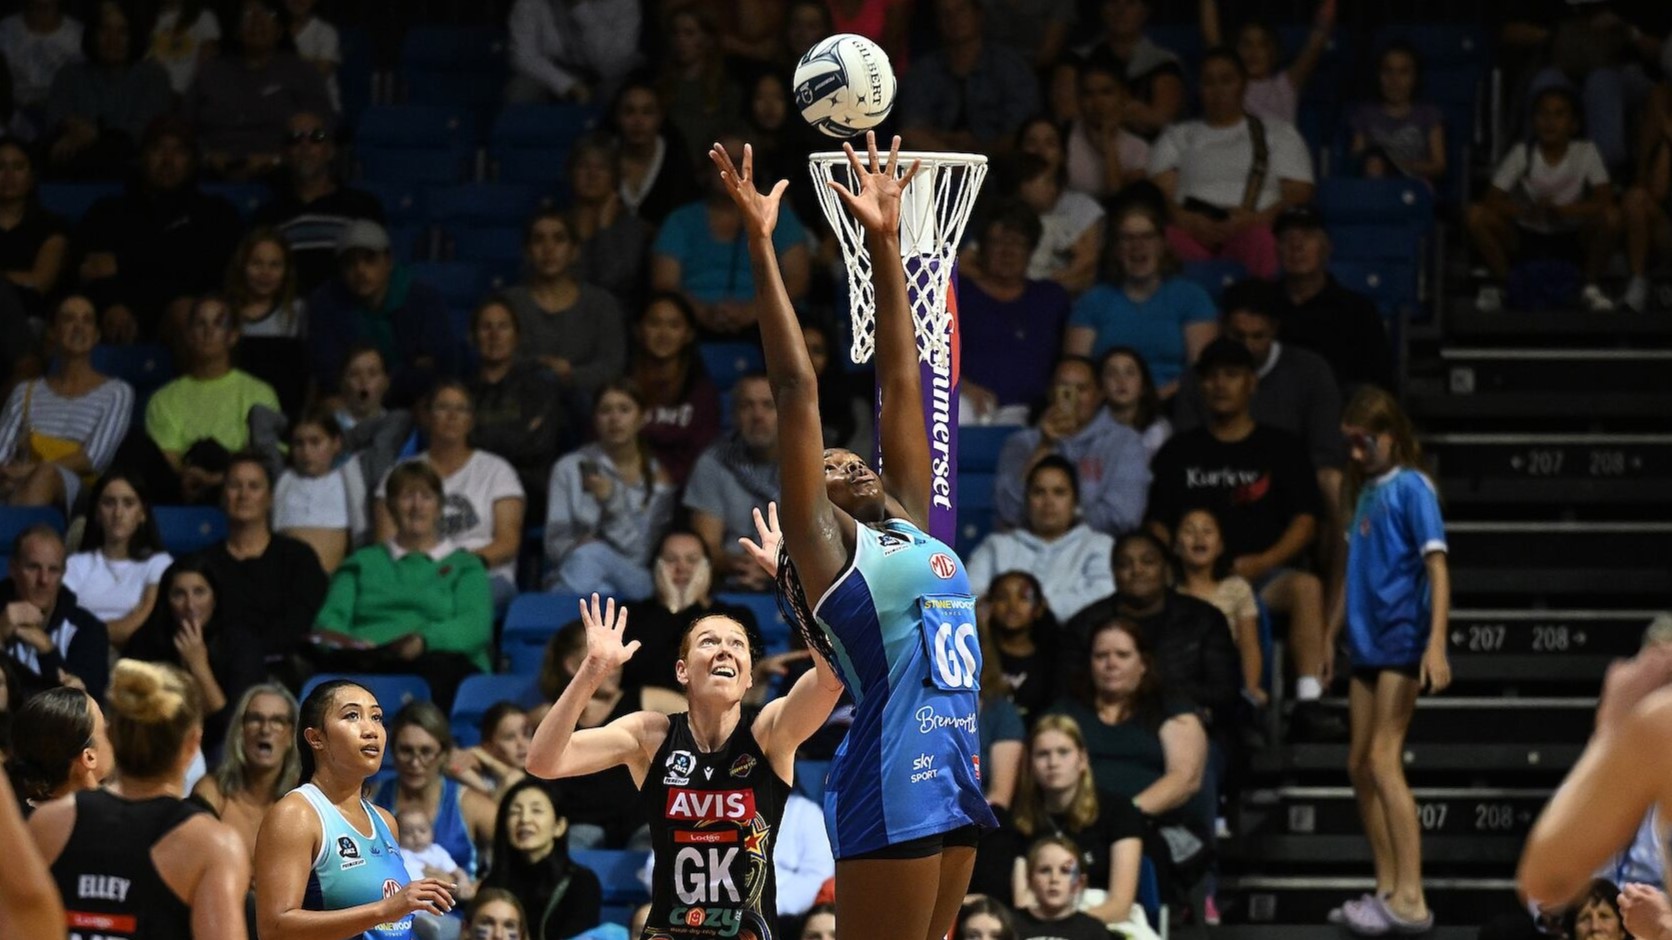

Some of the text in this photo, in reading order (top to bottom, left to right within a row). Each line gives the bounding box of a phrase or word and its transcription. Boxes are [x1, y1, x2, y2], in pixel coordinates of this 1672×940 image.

[852, 40, 882, 105] GILBERT
[1528, 450, 1626, 476] 207 208
[932, 555, 955, 577] MG
[1469, 625, 1570, 651] 207 208
[935, 622, 977, 688] GS
[913, 753, 935, 770] sky
[911, 769, 938, 783] SPORT
[669, 792, 746, 818] AVIS
[1475, 803, 1514, 831] 208
[690, 834, 720, 843] Lodge
[77, 874, 131, 902] ELLEY
[674, 846, 740, 905] GK
